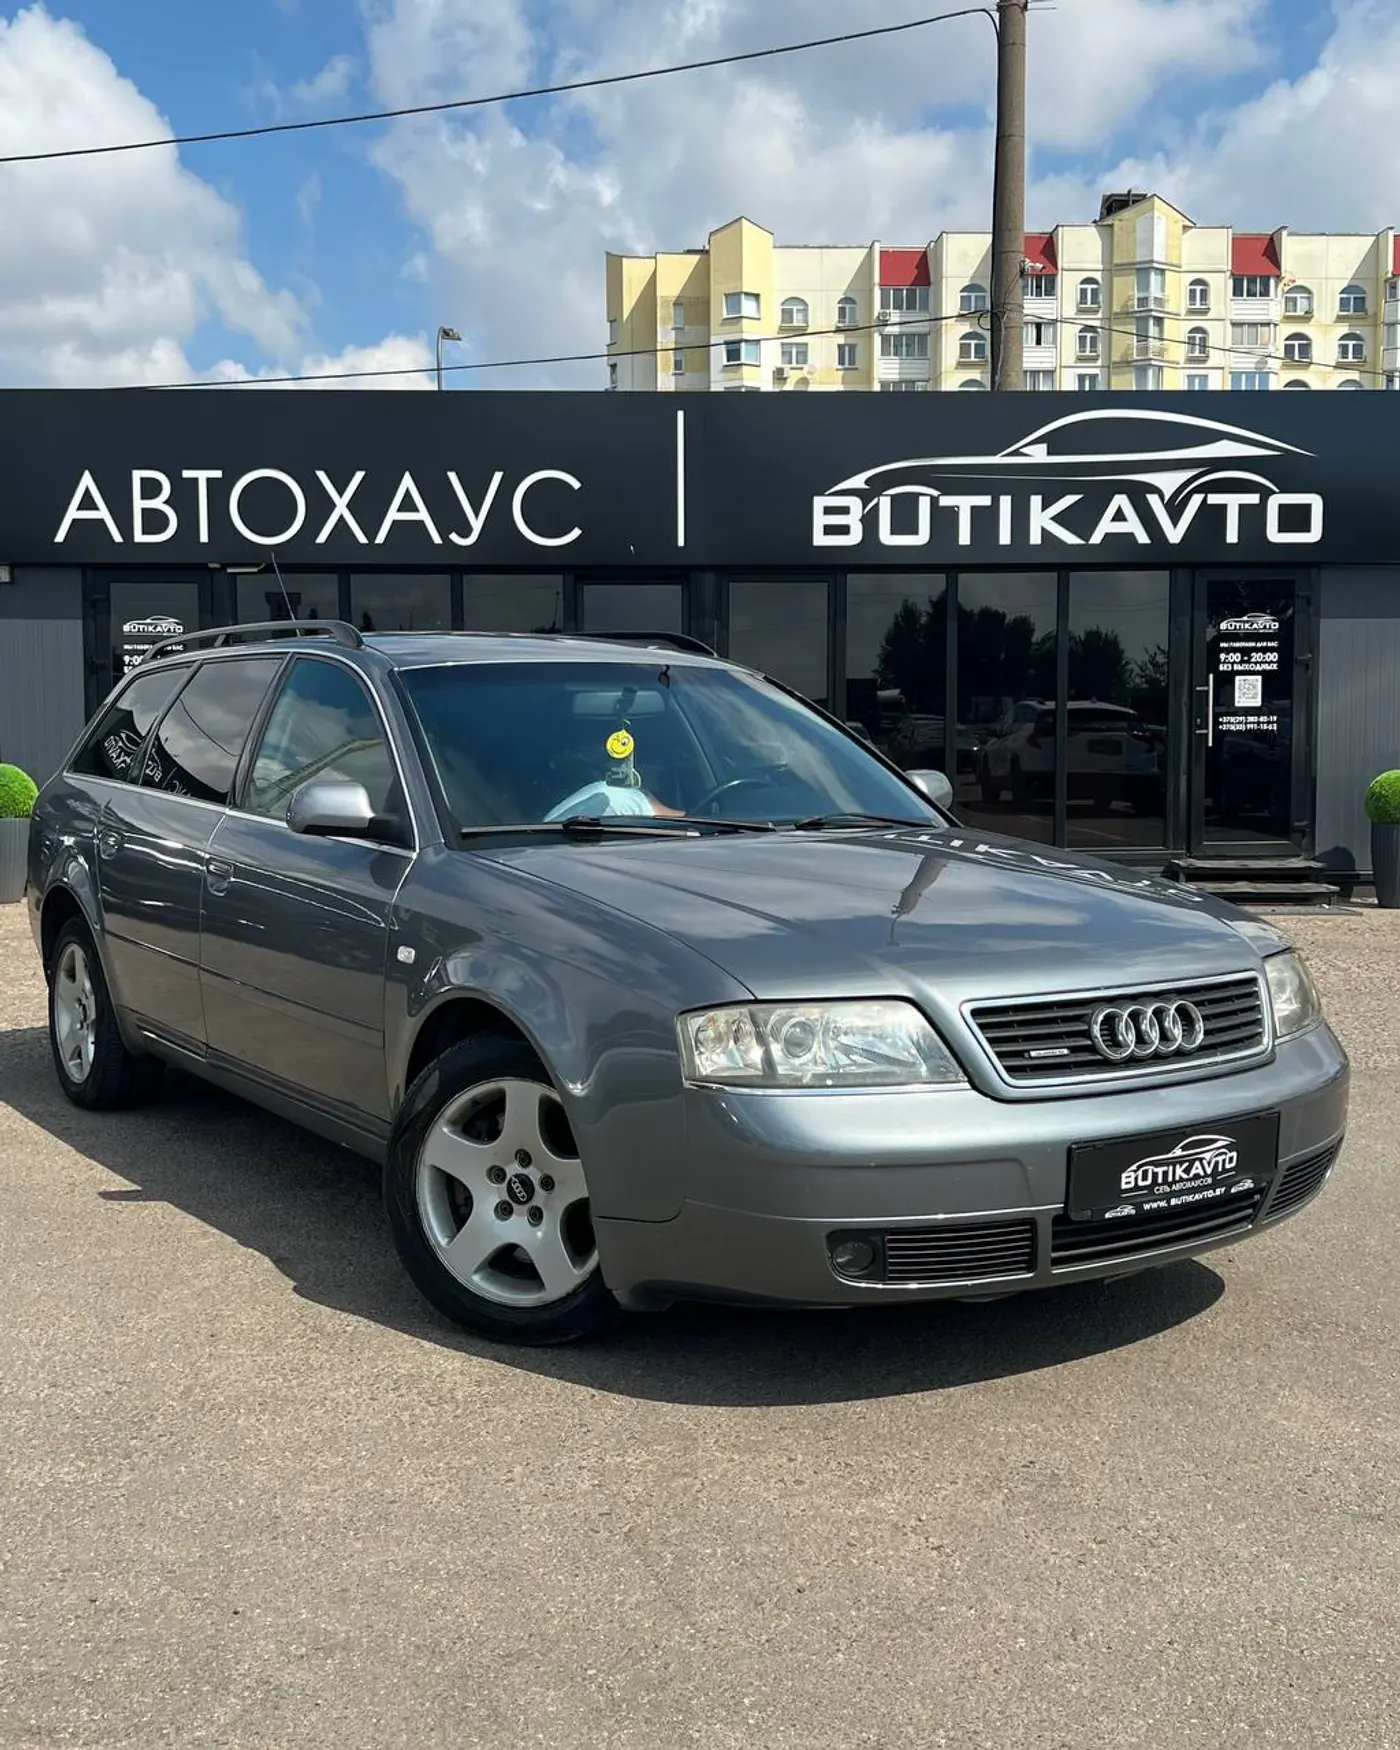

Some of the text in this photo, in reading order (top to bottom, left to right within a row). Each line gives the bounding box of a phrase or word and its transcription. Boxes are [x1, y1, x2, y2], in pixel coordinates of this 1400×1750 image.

[53, 467, 583, 547] АВТОХАУС
[812, 492, 1323, 547] BUTIKAVTO
[122, 624, 183, 633] BUTIKAVTO
[1219, 621, 1279, 630] BUTIKAVTO
[1219, 652, 1241, 662] 9:00
[1250, 652, 1278, 662] 20:00
[1120, 1151, 1238, 1190] BUTIKAVTO
